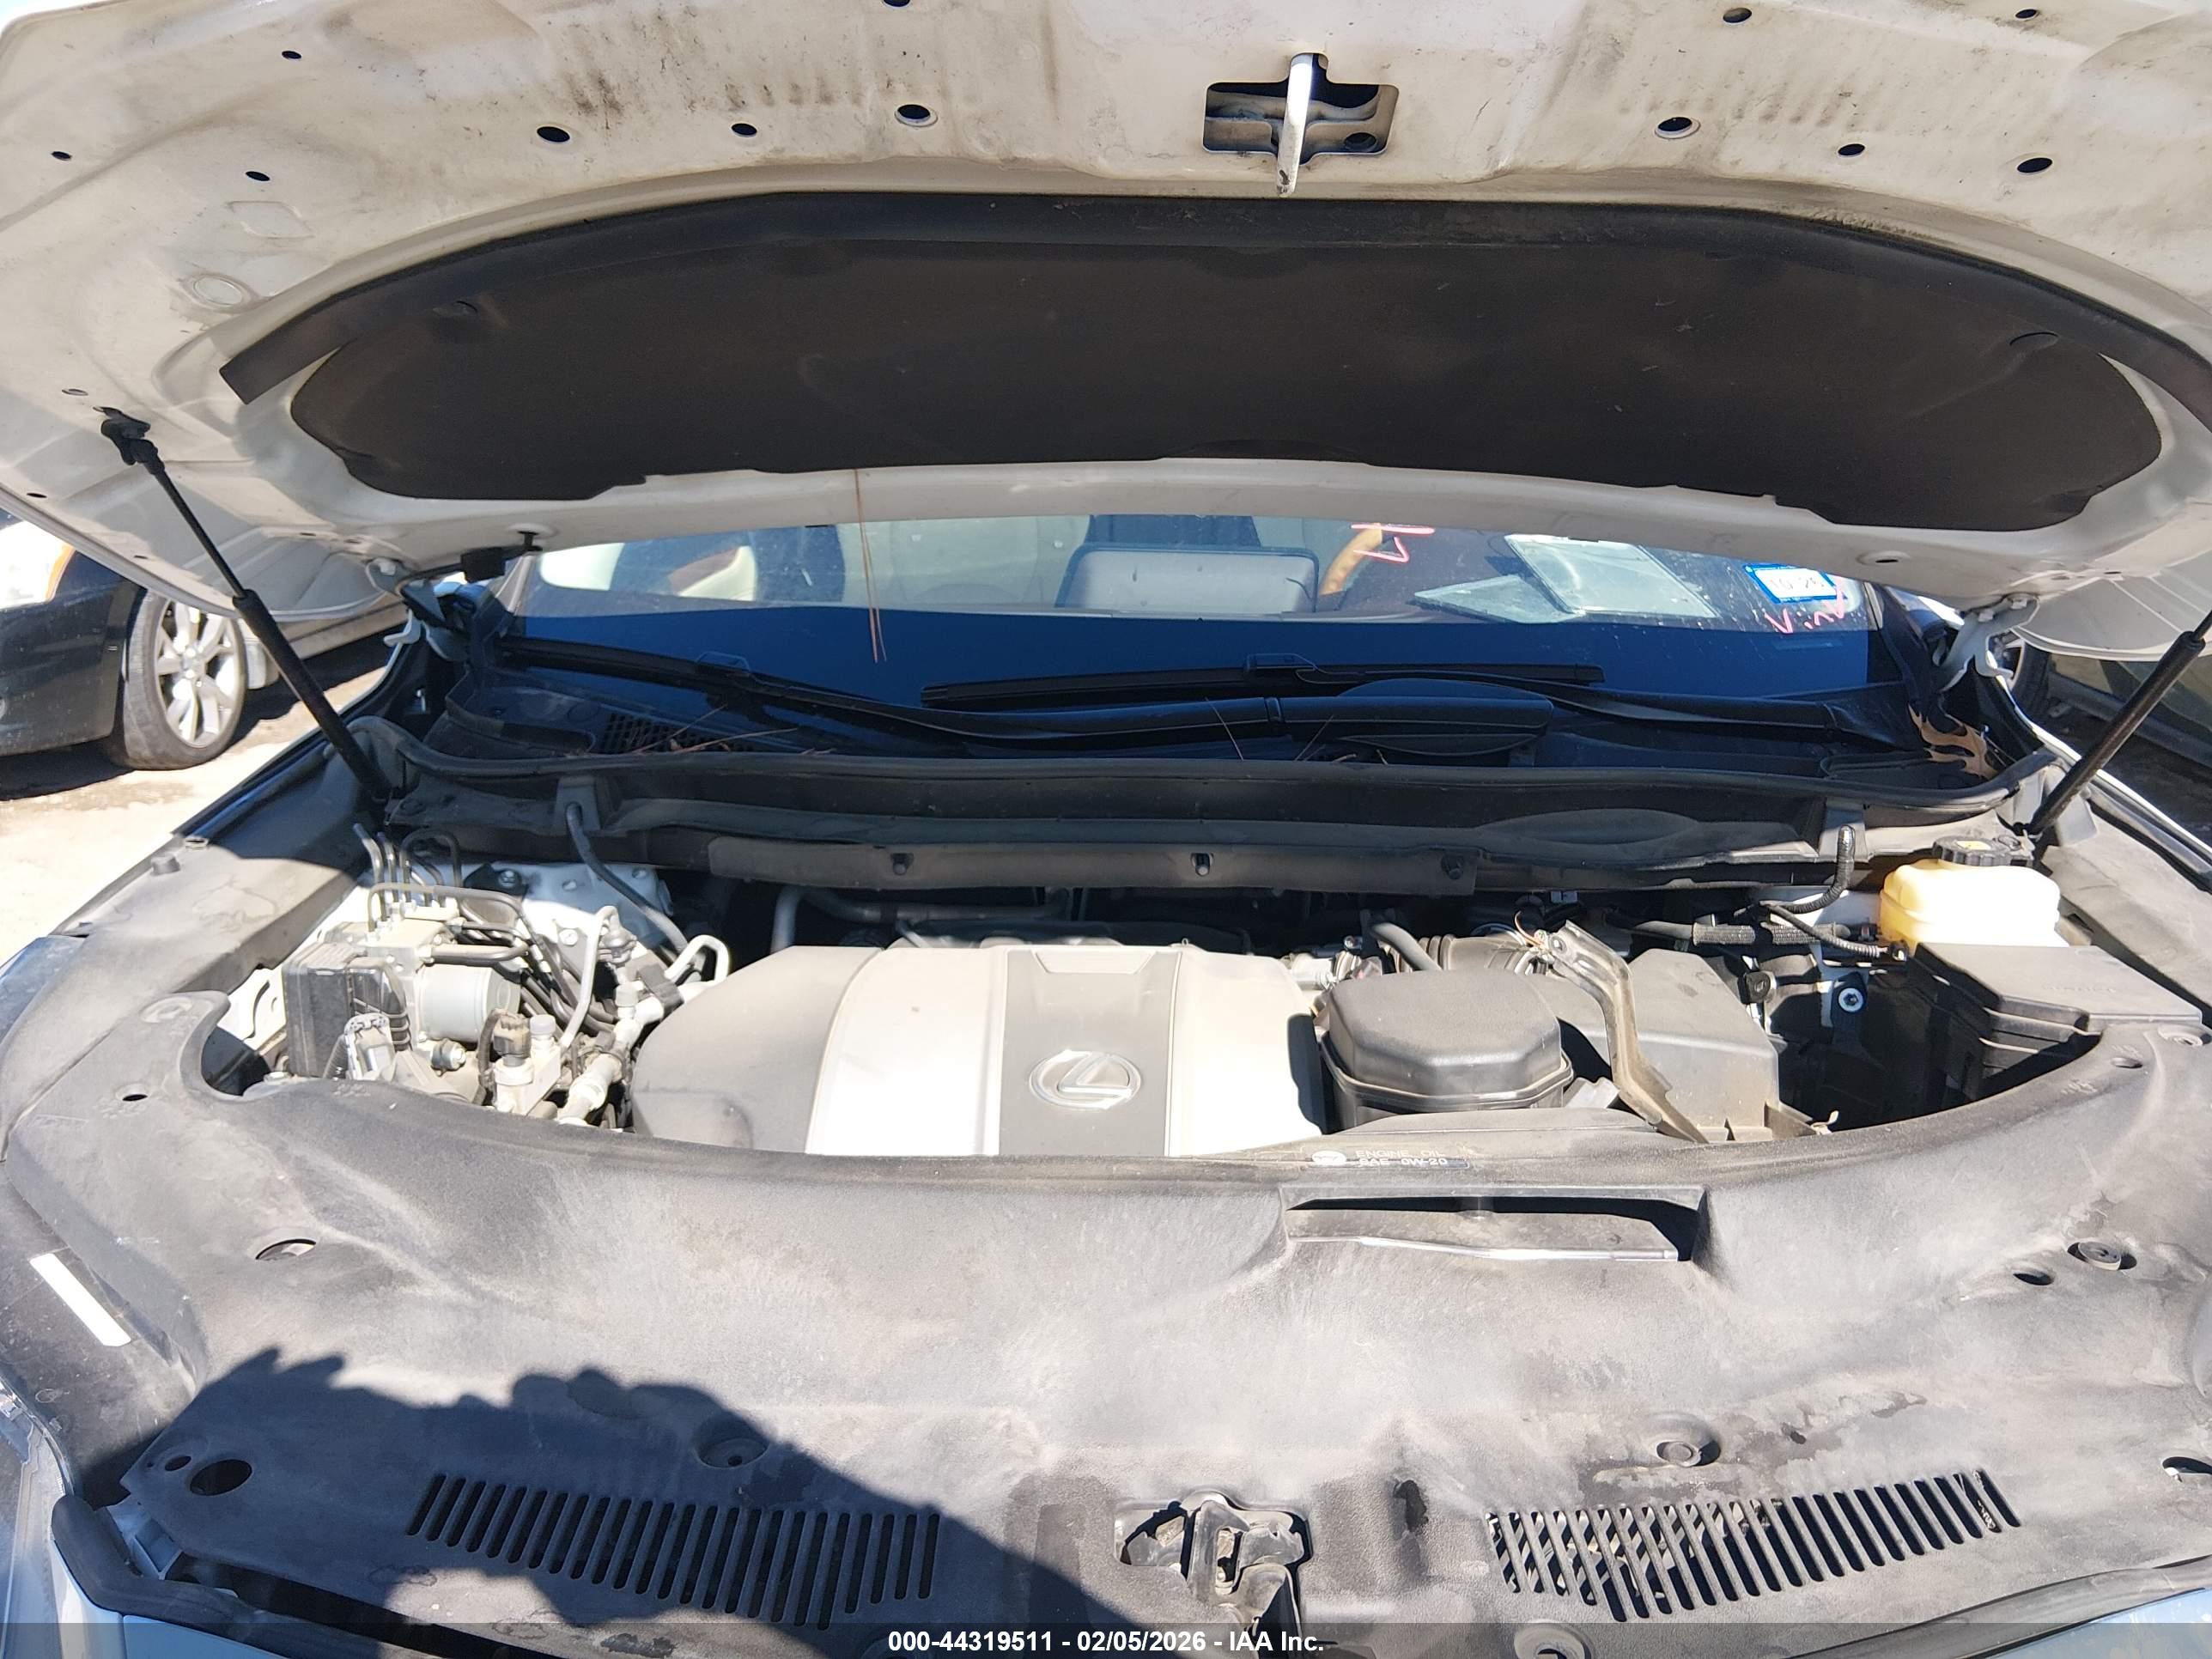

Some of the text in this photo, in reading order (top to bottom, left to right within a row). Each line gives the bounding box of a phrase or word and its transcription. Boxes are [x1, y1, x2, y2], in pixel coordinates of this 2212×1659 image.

[1355, 1150, 1409, 1158] ENGINE
[1420, 1150, 1446, 1158] OIL
[1358, 1158, 1449, 1166] SAE 0W-20
